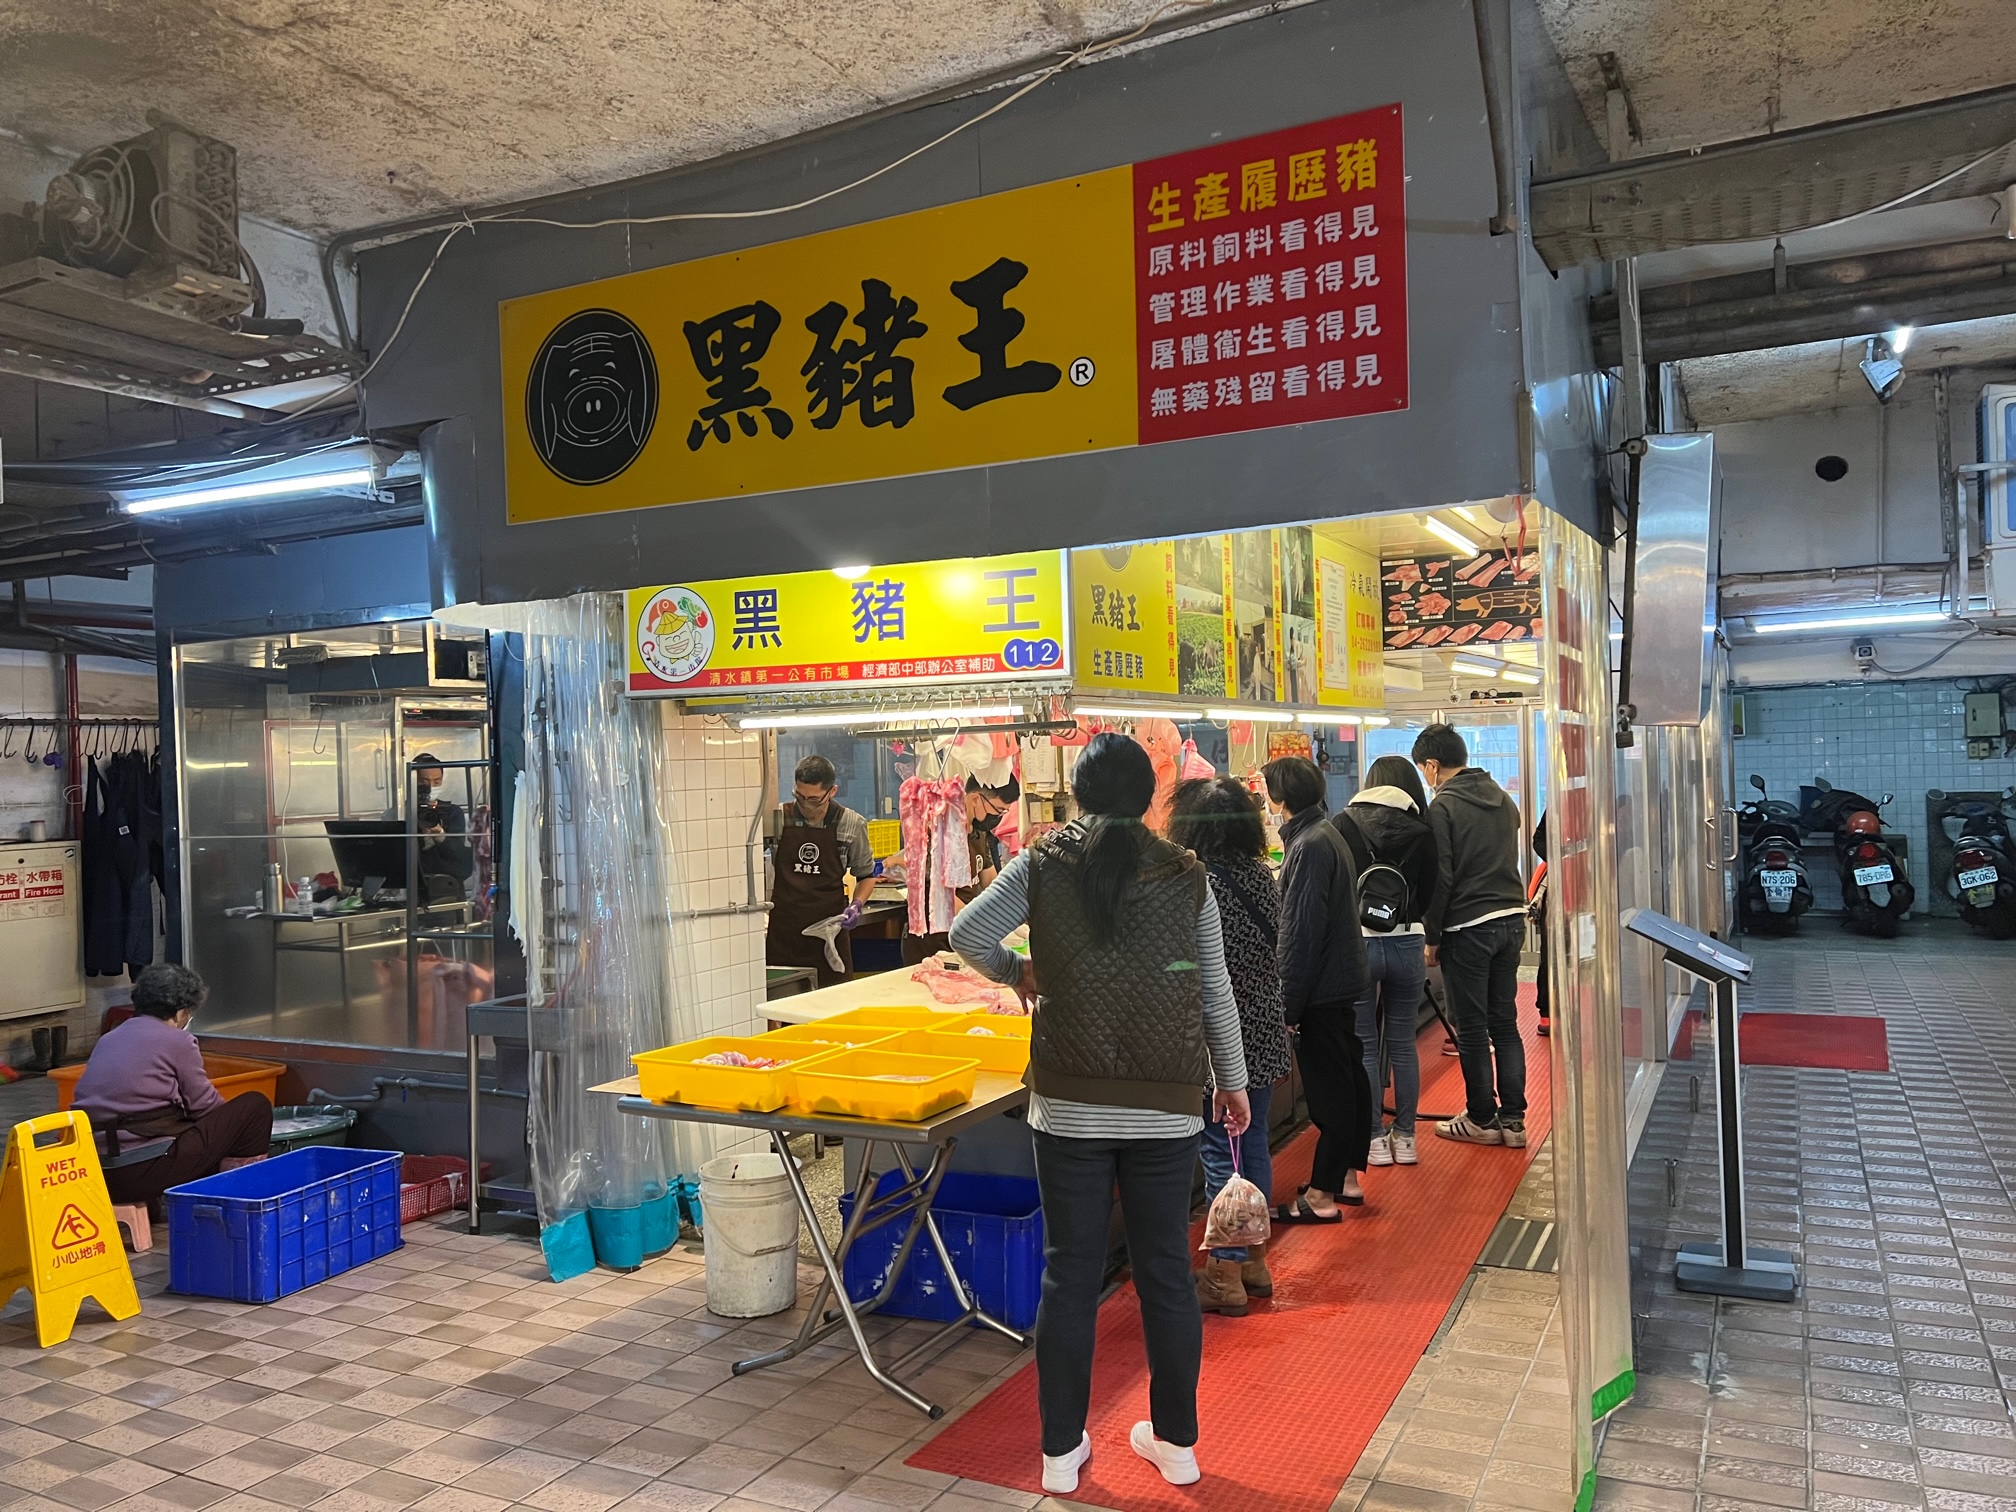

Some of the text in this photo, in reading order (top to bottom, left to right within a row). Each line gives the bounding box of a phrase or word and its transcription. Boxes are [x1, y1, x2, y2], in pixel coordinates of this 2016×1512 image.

[1147, 138, 1378, 233] 生產履歷豬
[1148, 204, 1380, 277] 原料飼料看得見
[1149, 254, 1381, 325] 管理作業看得見
[683, 257, 1062, 451] 黑豬王
[1151, 354, 1383, 418] 無藥殘留看得見
[732, 567, 1040, 651] 黑豬王
[1091, 584, 1141, 631] 黑豬王
[1009, 644, 1055, 666] 112
[1093, 648, 1143, 680] 生產履歷豬
[709, 657, 995, 685] 清水鎮第一公有市場 經濟部中部辦公室補助
[26, 870, 63, 883] 水帶箱
[1762, 875, 1796, 885] N7S-206
[1961, 871, 1997, 886] 3GK-062
[25, 889, 41, 897] Fire
[43, 887, 63, 896] Hose
[1367, 906, 1390, 920] PUMA
[40, 1167, 88, 1189] FLOOR
[46, 1157, 76, 1174] WET
[52, 1241, 106, 1269] 小心地滑
